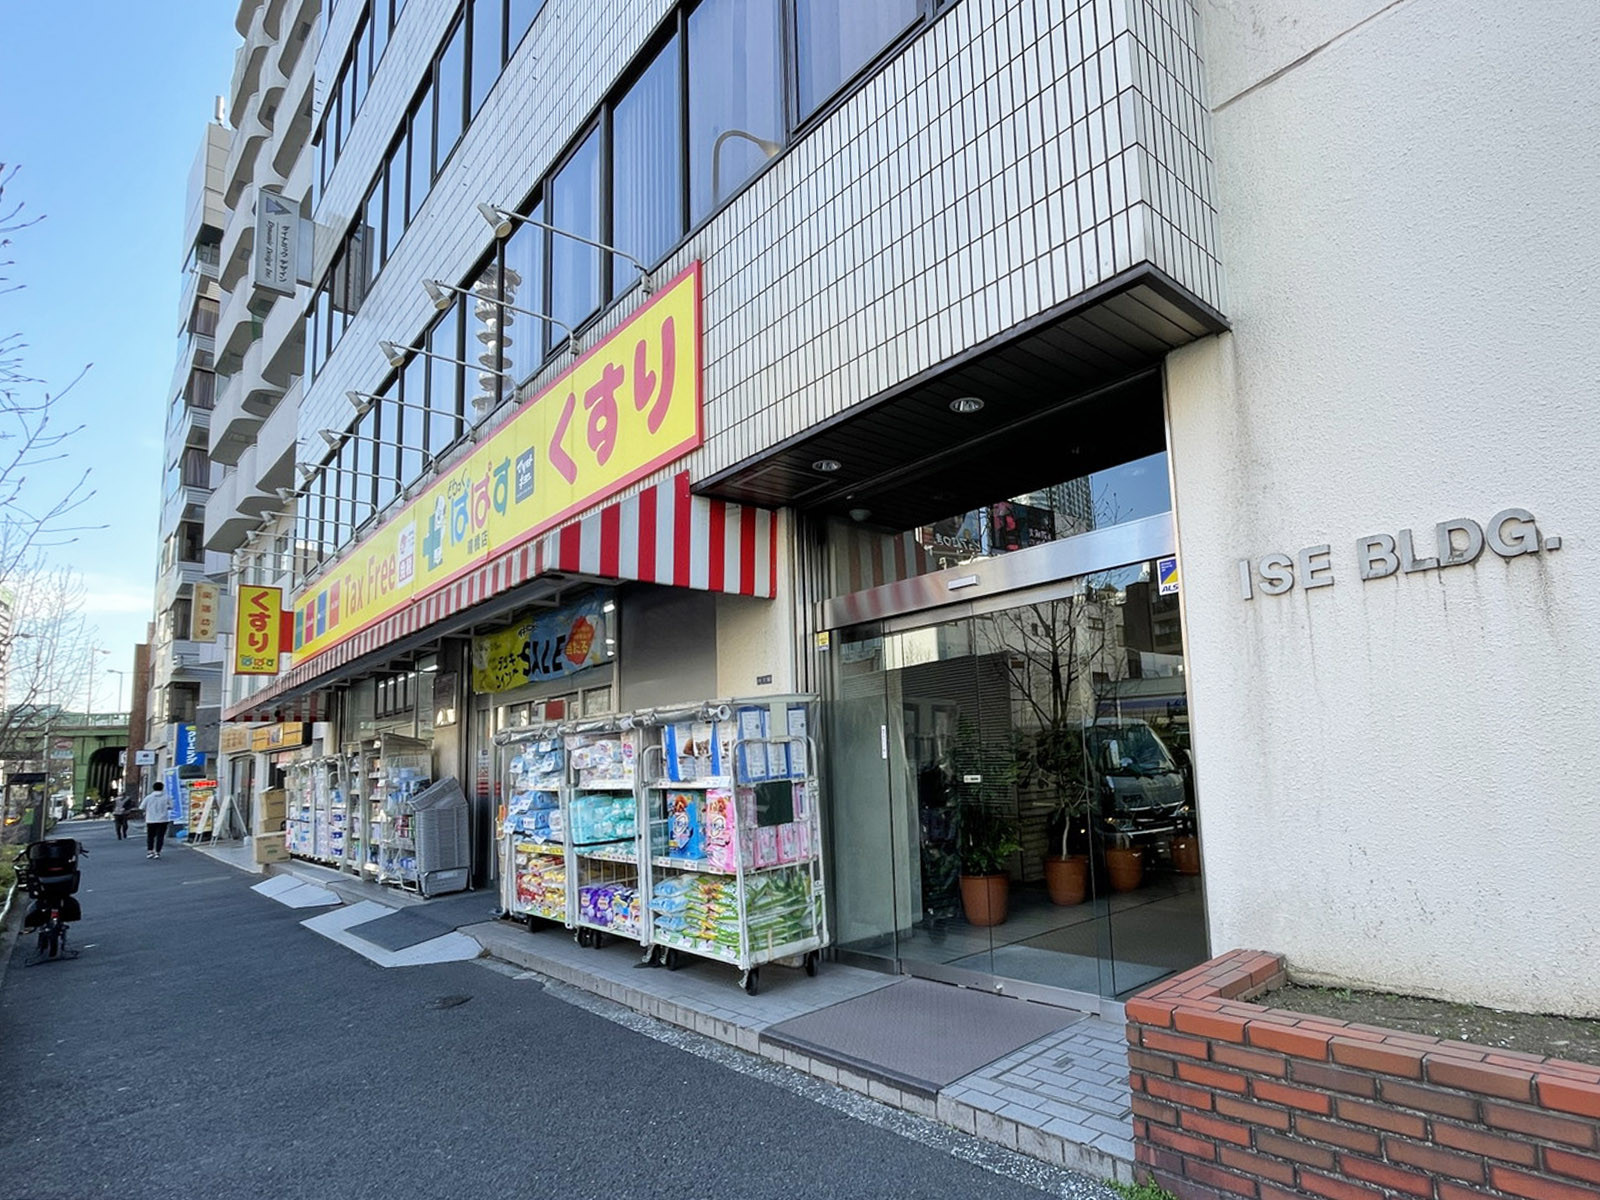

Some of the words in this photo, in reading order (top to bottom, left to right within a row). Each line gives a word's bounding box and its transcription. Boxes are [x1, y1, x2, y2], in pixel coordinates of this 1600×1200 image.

[264, 246, 274, 267] Design
[549, 316, 675, 485] くすり
[1238, 544, 1334, 600] ISE
[1356, 507, 1562, 581] BLDG.
[345, 574, 364, 619] Tax
[367, 553, 396, 605] Free
[248, 591, 272, 653] くすり
[517, 634, 567, 678] SALE
